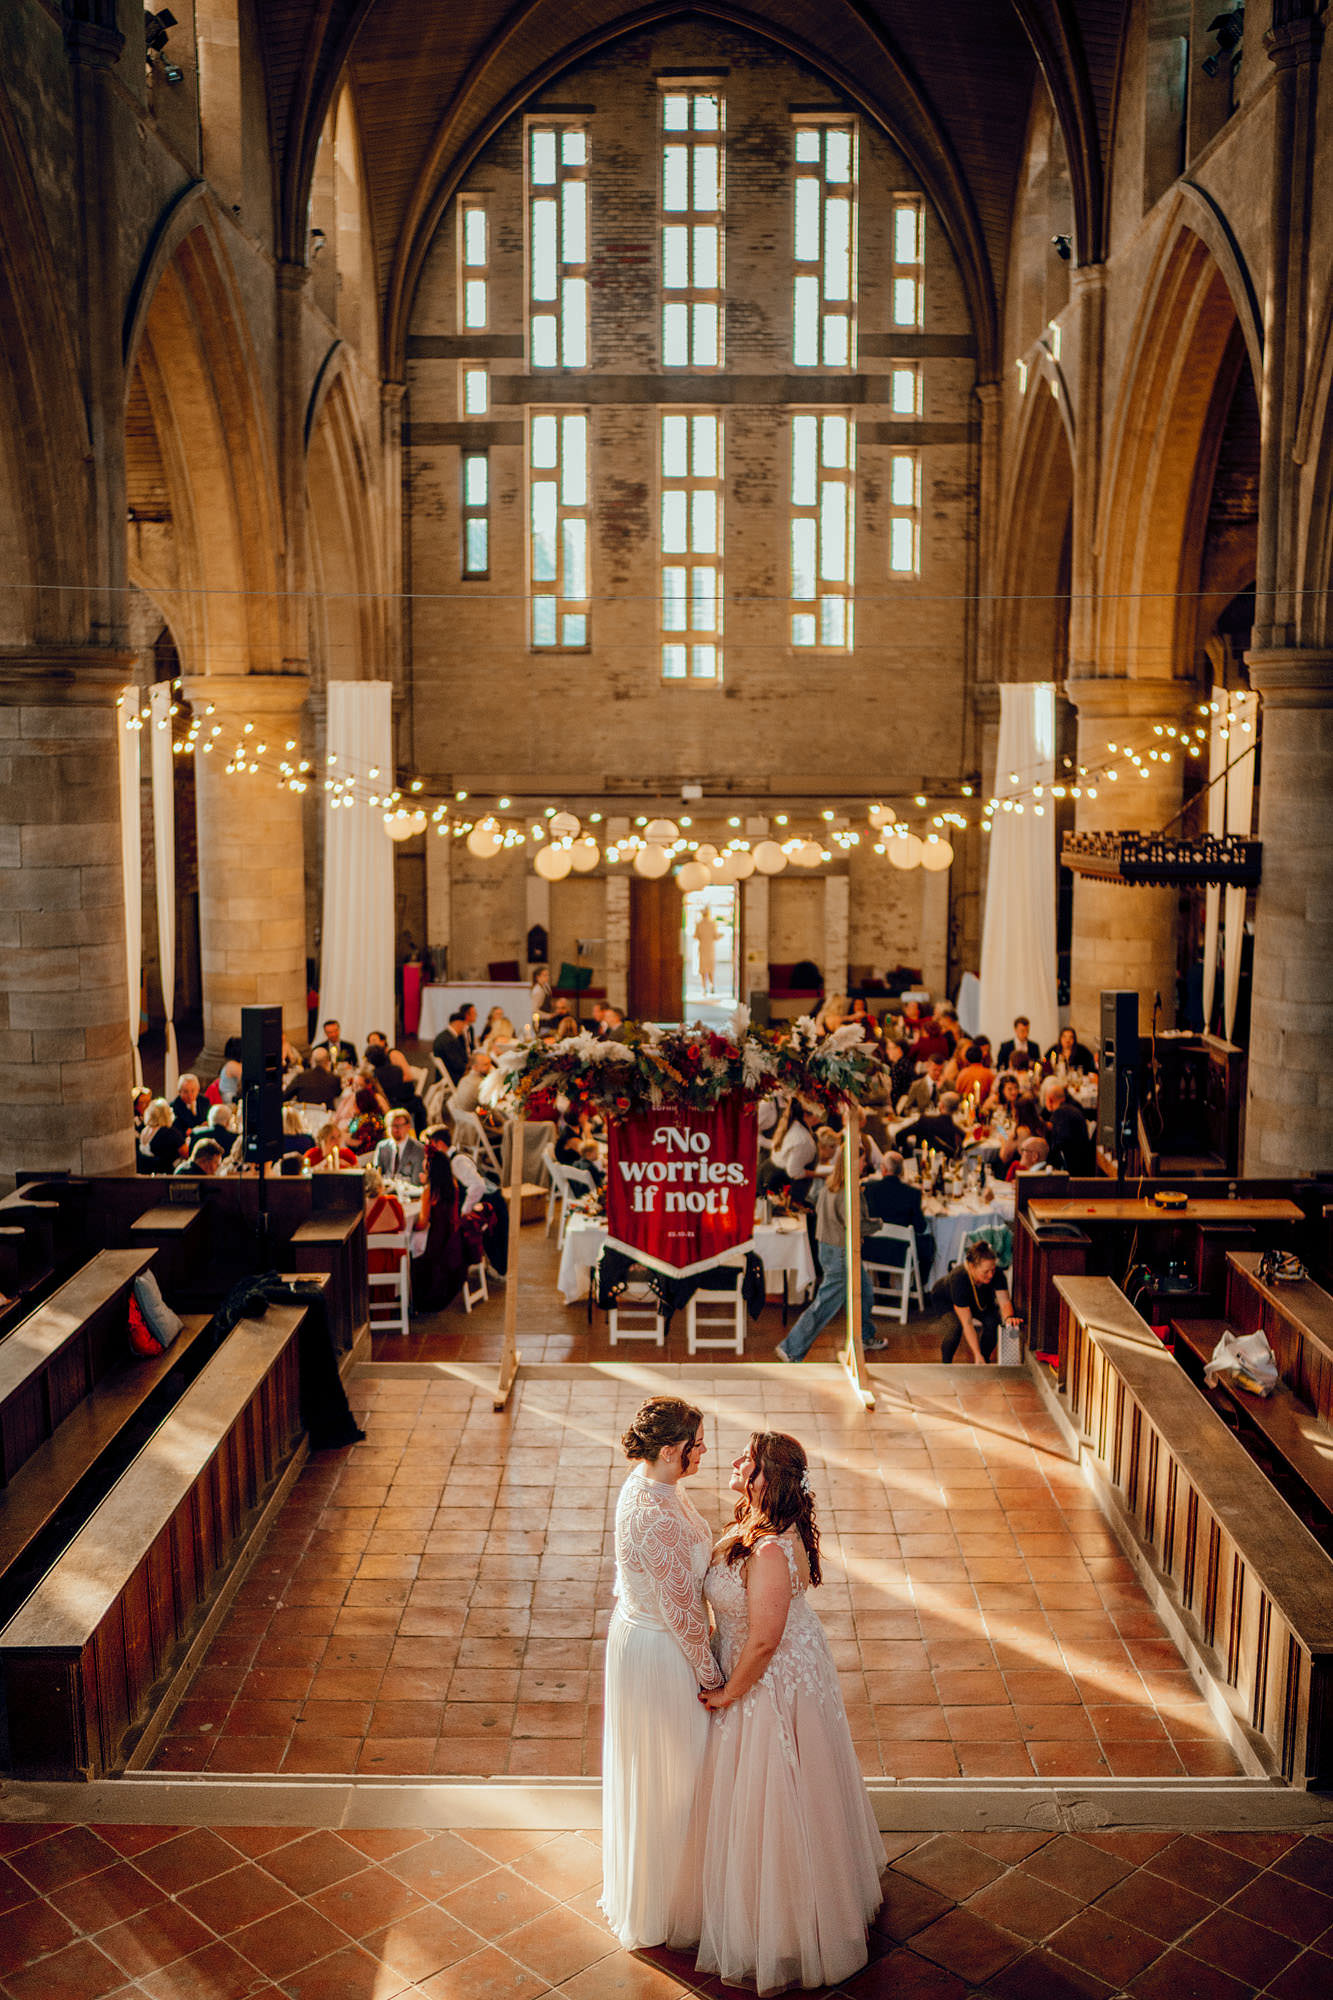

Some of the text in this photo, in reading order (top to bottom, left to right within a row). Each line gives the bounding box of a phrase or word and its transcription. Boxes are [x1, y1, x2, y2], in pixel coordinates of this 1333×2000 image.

[652, 1126, 711, 1154] No
[630, 1185, 730, 1214] if not!
